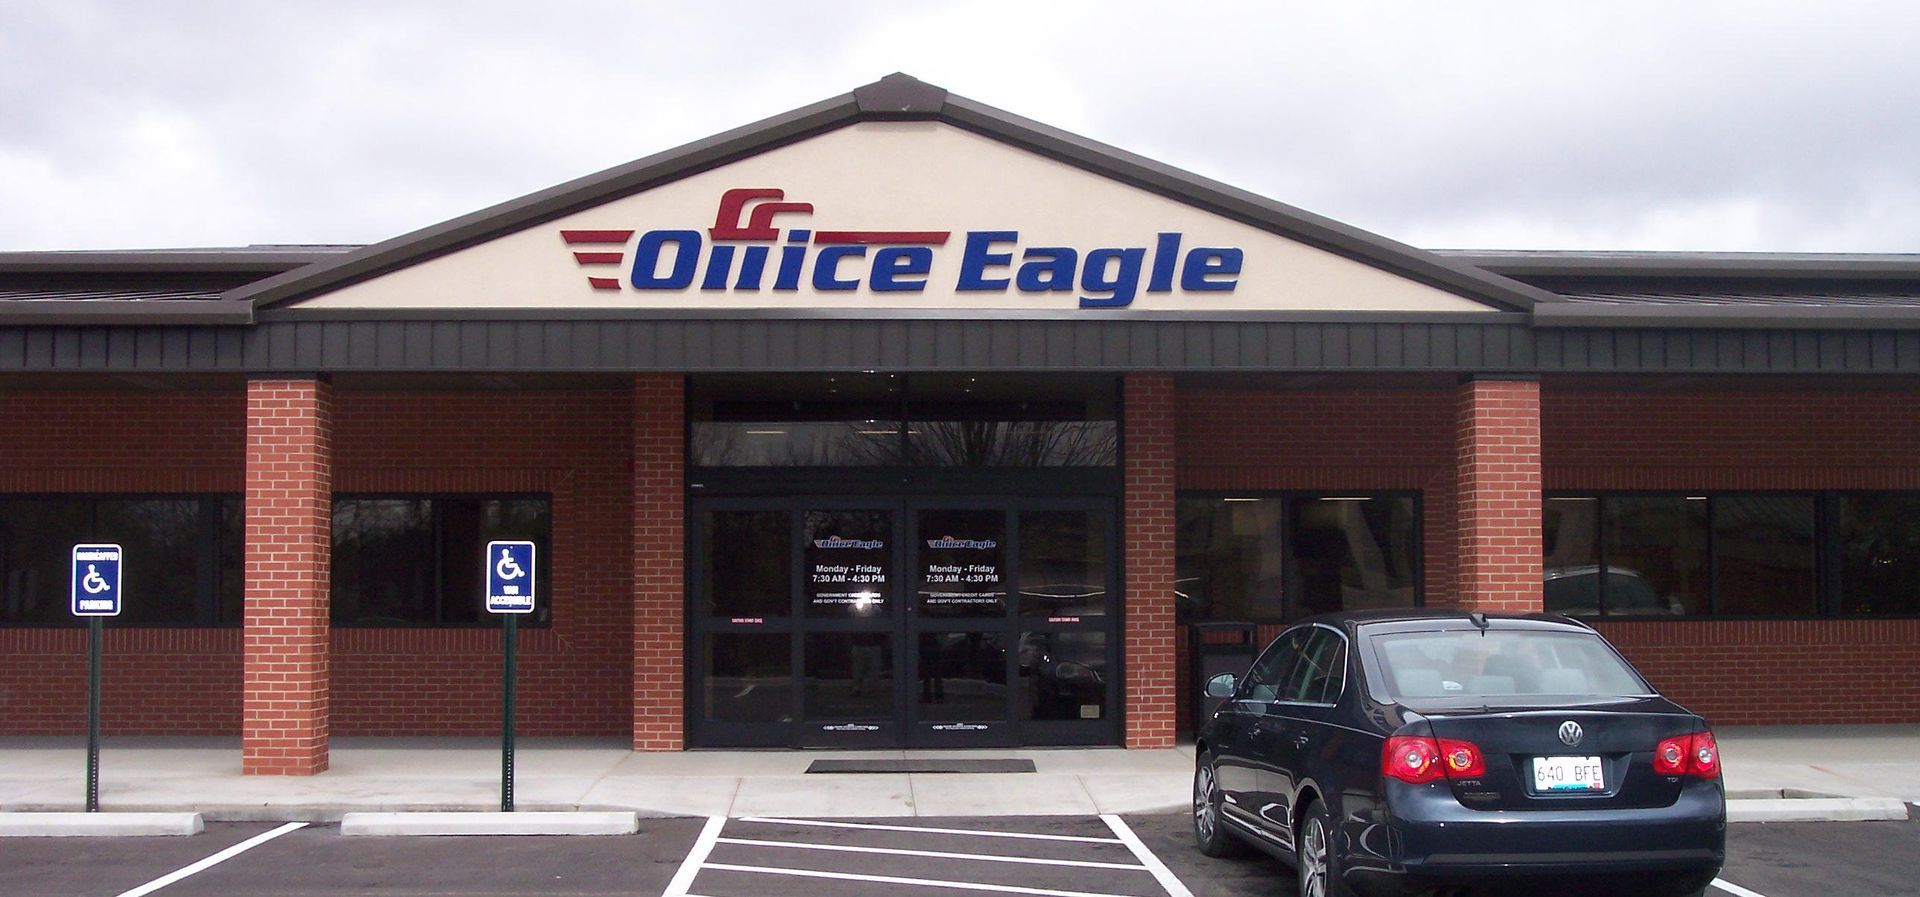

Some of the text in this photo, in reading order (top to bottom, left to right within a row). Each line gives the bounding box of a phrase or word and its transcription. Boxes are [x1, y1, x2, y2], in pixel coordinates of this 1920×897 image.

[630, 188, 1245, 309] Office Eagle
[816, 565, 849, 574] Monday
[856, 565, 882, 574] Friday
[929, 565, 962, 574] Monday
[969, 565, 995, 574] Friday
[813, 575, 830, 583] 7:30
[832, 575, 846, 583] AM
[852, 575, 870, 583] 4:30
[872, 575, 885, 583] PM
[926, 575, 943, 583] 7:30
[945, 575, 959, 583] AM
[965, 575, 984, 583] 4:30
[985, 575, 999, 583] PM
[1538, 765, 1601, 782] 640 BFE
